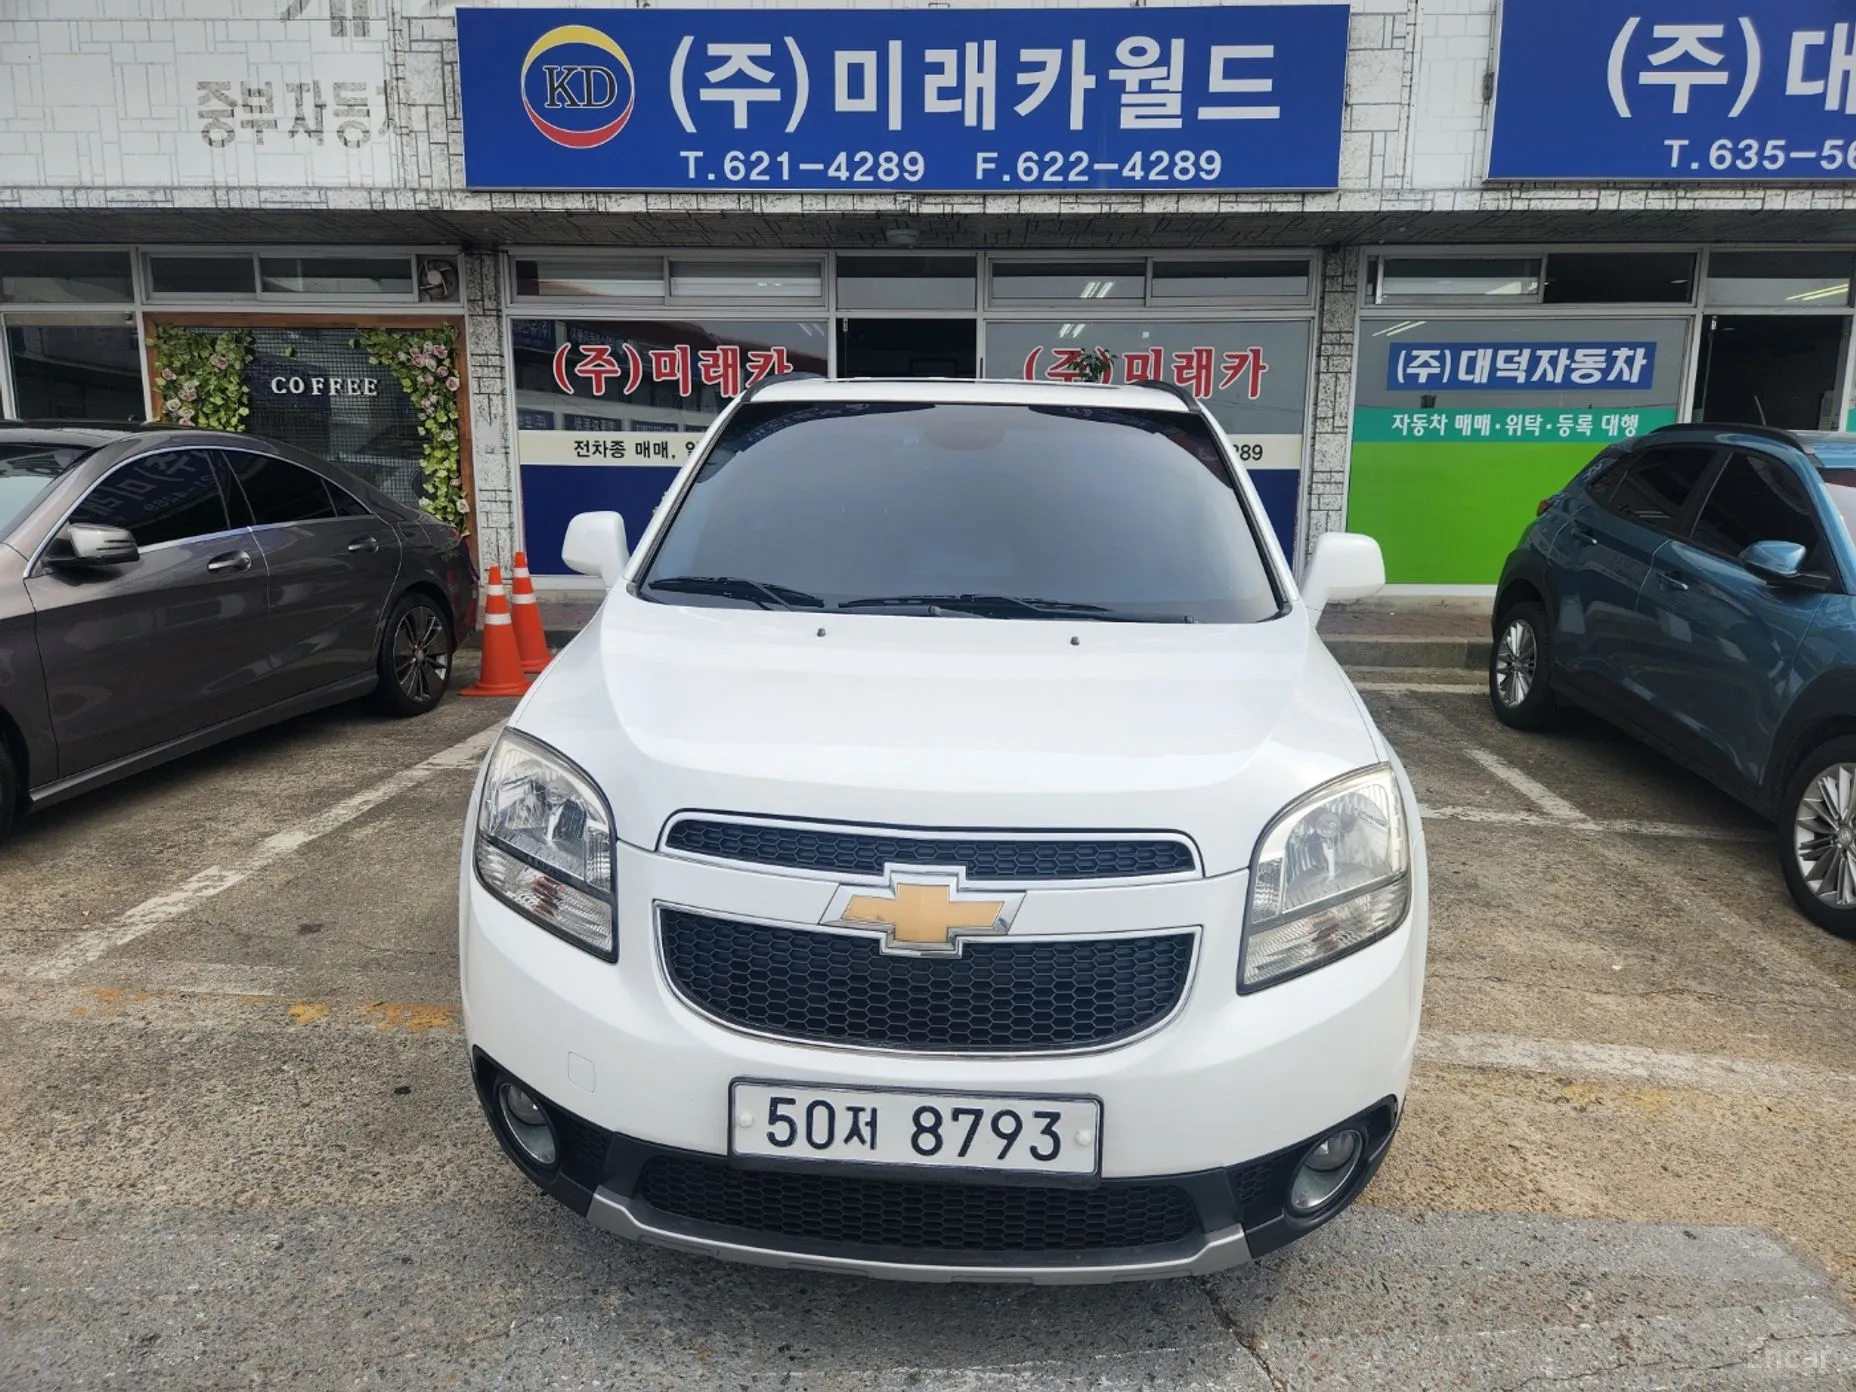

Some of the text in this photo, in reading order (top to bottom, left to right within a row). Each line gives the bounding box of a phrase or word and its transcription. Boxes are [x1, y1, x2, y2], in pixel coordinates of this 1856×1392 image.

[543, 65, 618, 108] KD
[669, 35, 1281, 133] (주)미래카월드
[680, 150, 1222, 182] T.621-4289 F.622-4289
[553, 342, 793, 397] (주)미래카
[1397, 347, 1647, 384] (주)대덕자동차
[1392, 413, 1448, 436] 자동차
[1601, 413, 1639, 437] 대행
[574, 440, 626, 459] 전차종
[766, 1096, 1062, 1161] 50저 8793
